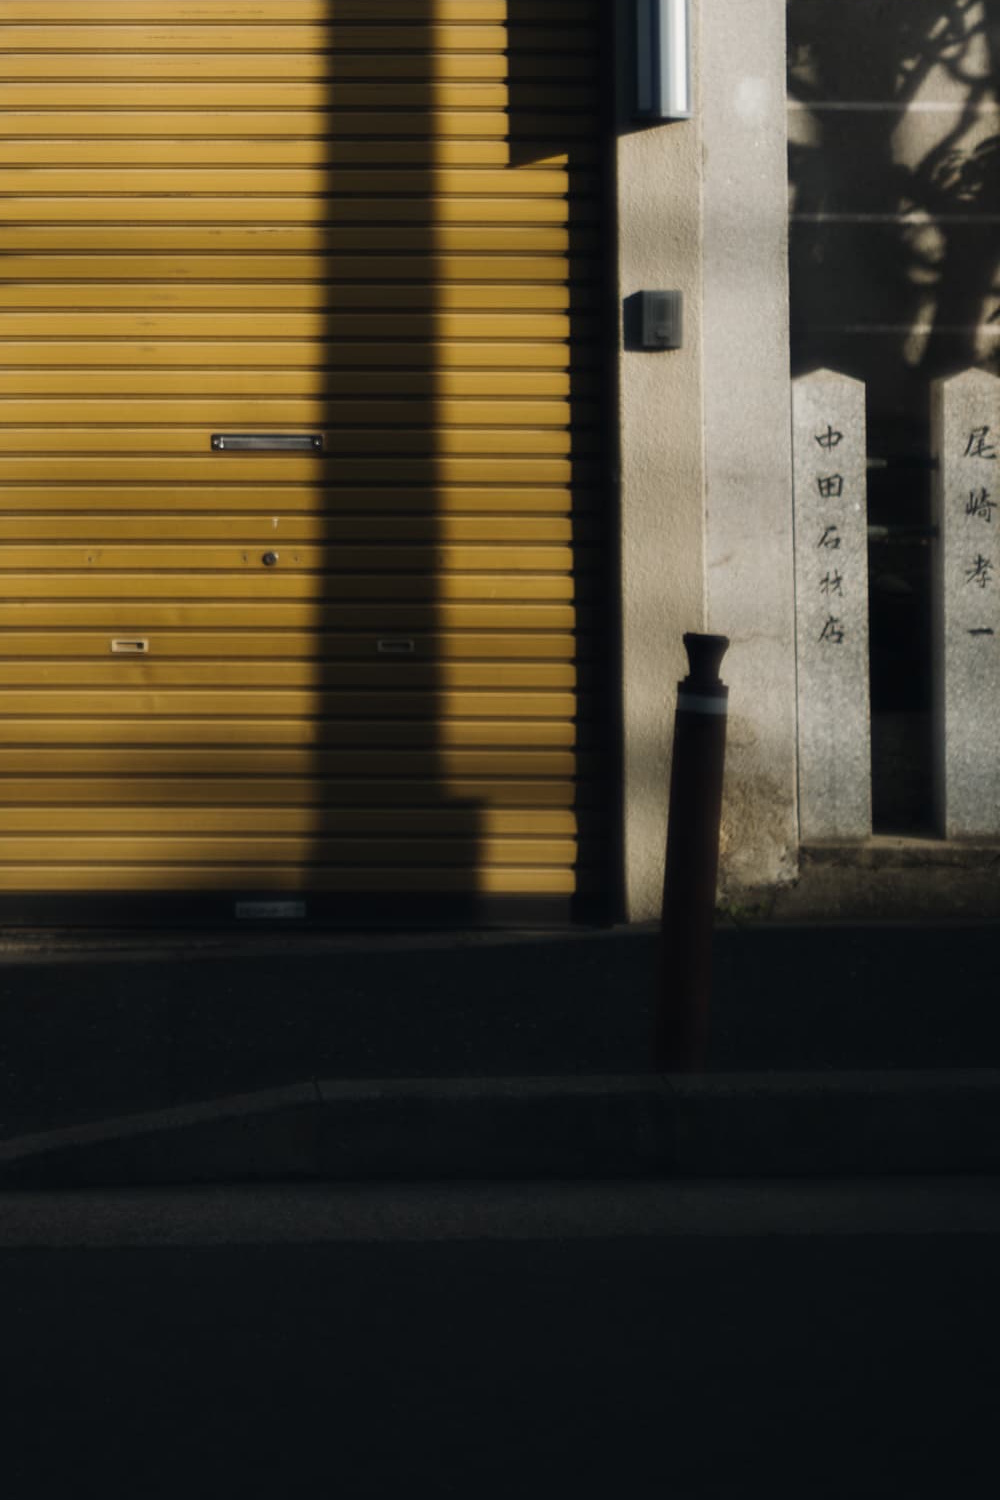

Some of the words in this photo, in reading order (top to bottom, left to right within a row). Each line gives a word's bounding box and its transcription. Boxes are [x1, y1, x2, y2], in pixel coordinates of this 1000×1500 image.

[813, 424, 845, 645] 中田石材店
[963, 425, 999, 637] 尾崎孝一
